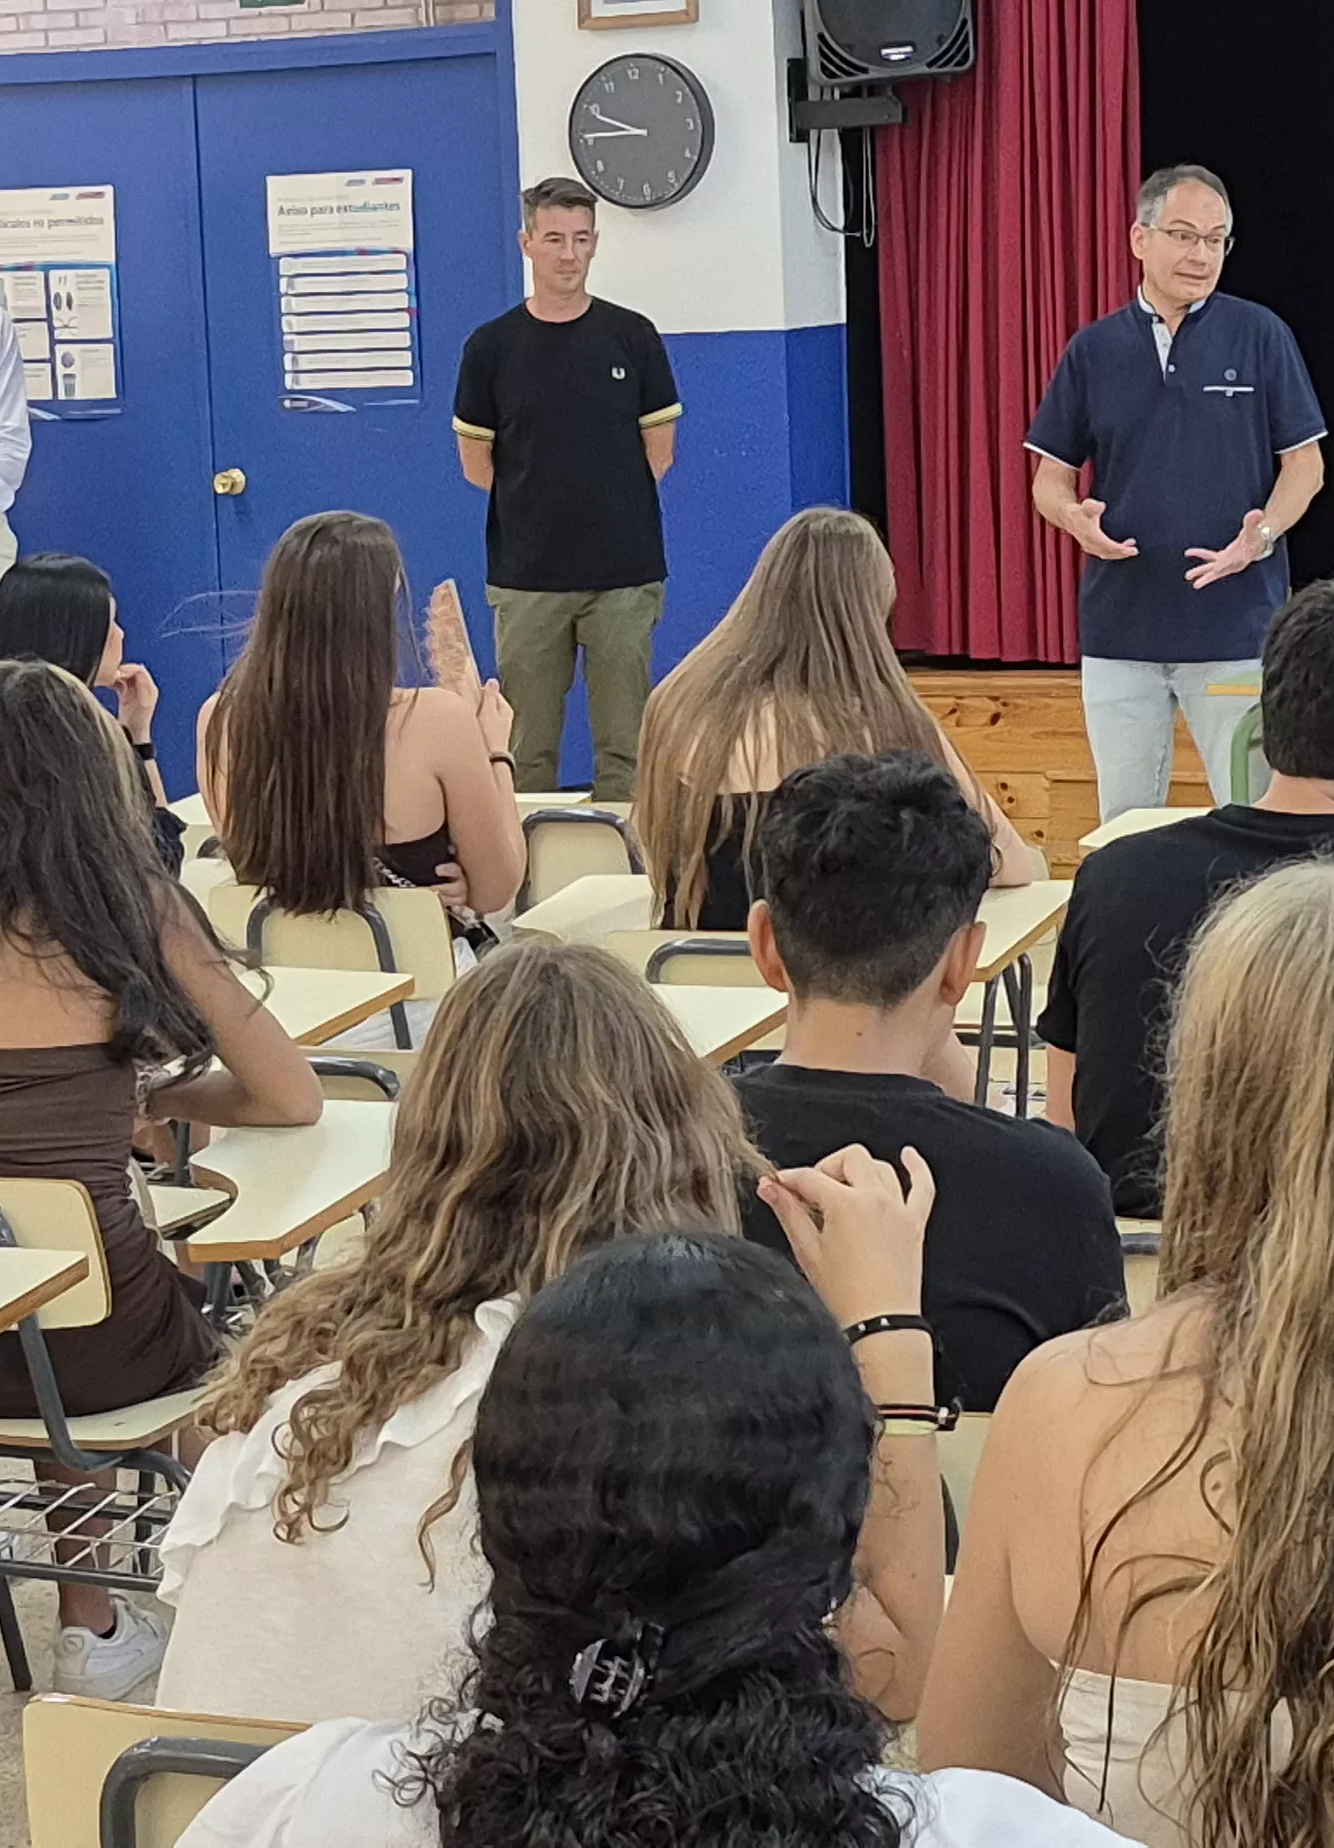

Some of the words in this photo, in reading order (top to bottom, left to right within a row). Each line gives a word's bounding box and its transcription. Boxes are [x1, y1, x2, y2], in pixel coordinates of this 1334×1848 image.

[627, 67, 639, 80] 12
[657, 72, 664, 85] 1
[604, 81, 615, 93] 11
[675, 90, 683, 103] 2
[685, 118, 694, 130] 3
[617, 177, 625, 191] 7
[310, 204, 334, 217] para
